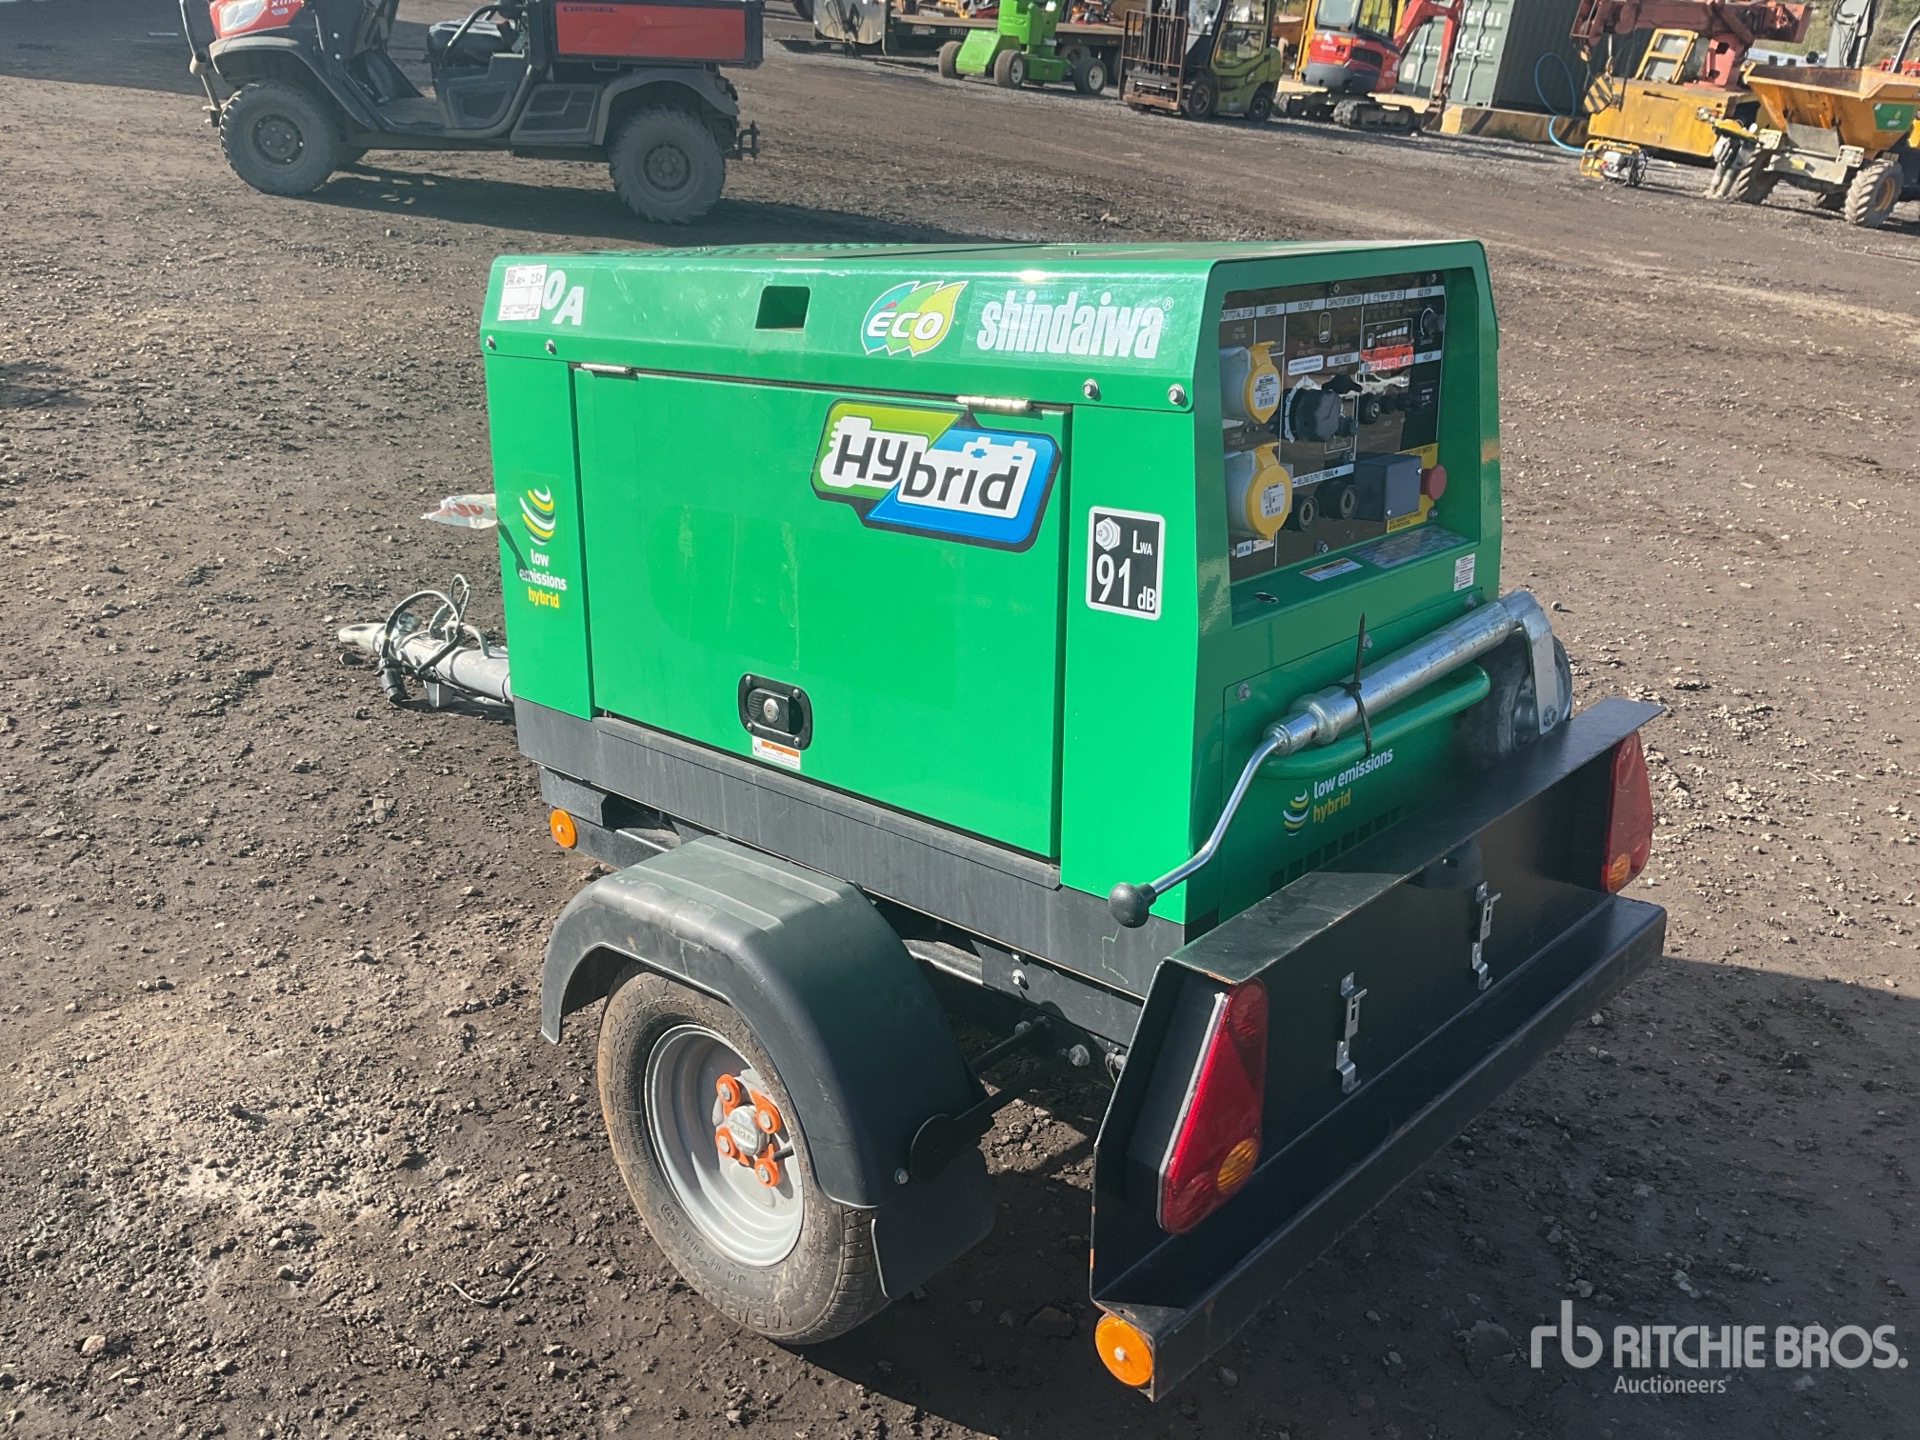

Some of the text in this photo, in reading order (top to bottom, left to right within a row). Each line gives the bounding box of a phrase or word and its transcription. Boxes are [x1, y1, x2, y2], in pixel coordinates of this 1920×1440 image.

[1298, 301, 1314, 311] OUTPUT
[976, 290, 1165, 359] shindaiwa
[833, 434, 1019, 510] Hybrid
[530, 548, 549, 567] low
[519, 568, 568, 591] emissions
[1096, 553, 1131, 607] 91
[528, 587, 560, 609] hybrid
[1137, 586, 1156, 611] dB
[1313, 748, 1393, 799] low emissions
[1313, 787, 1351, 823] hybrid
